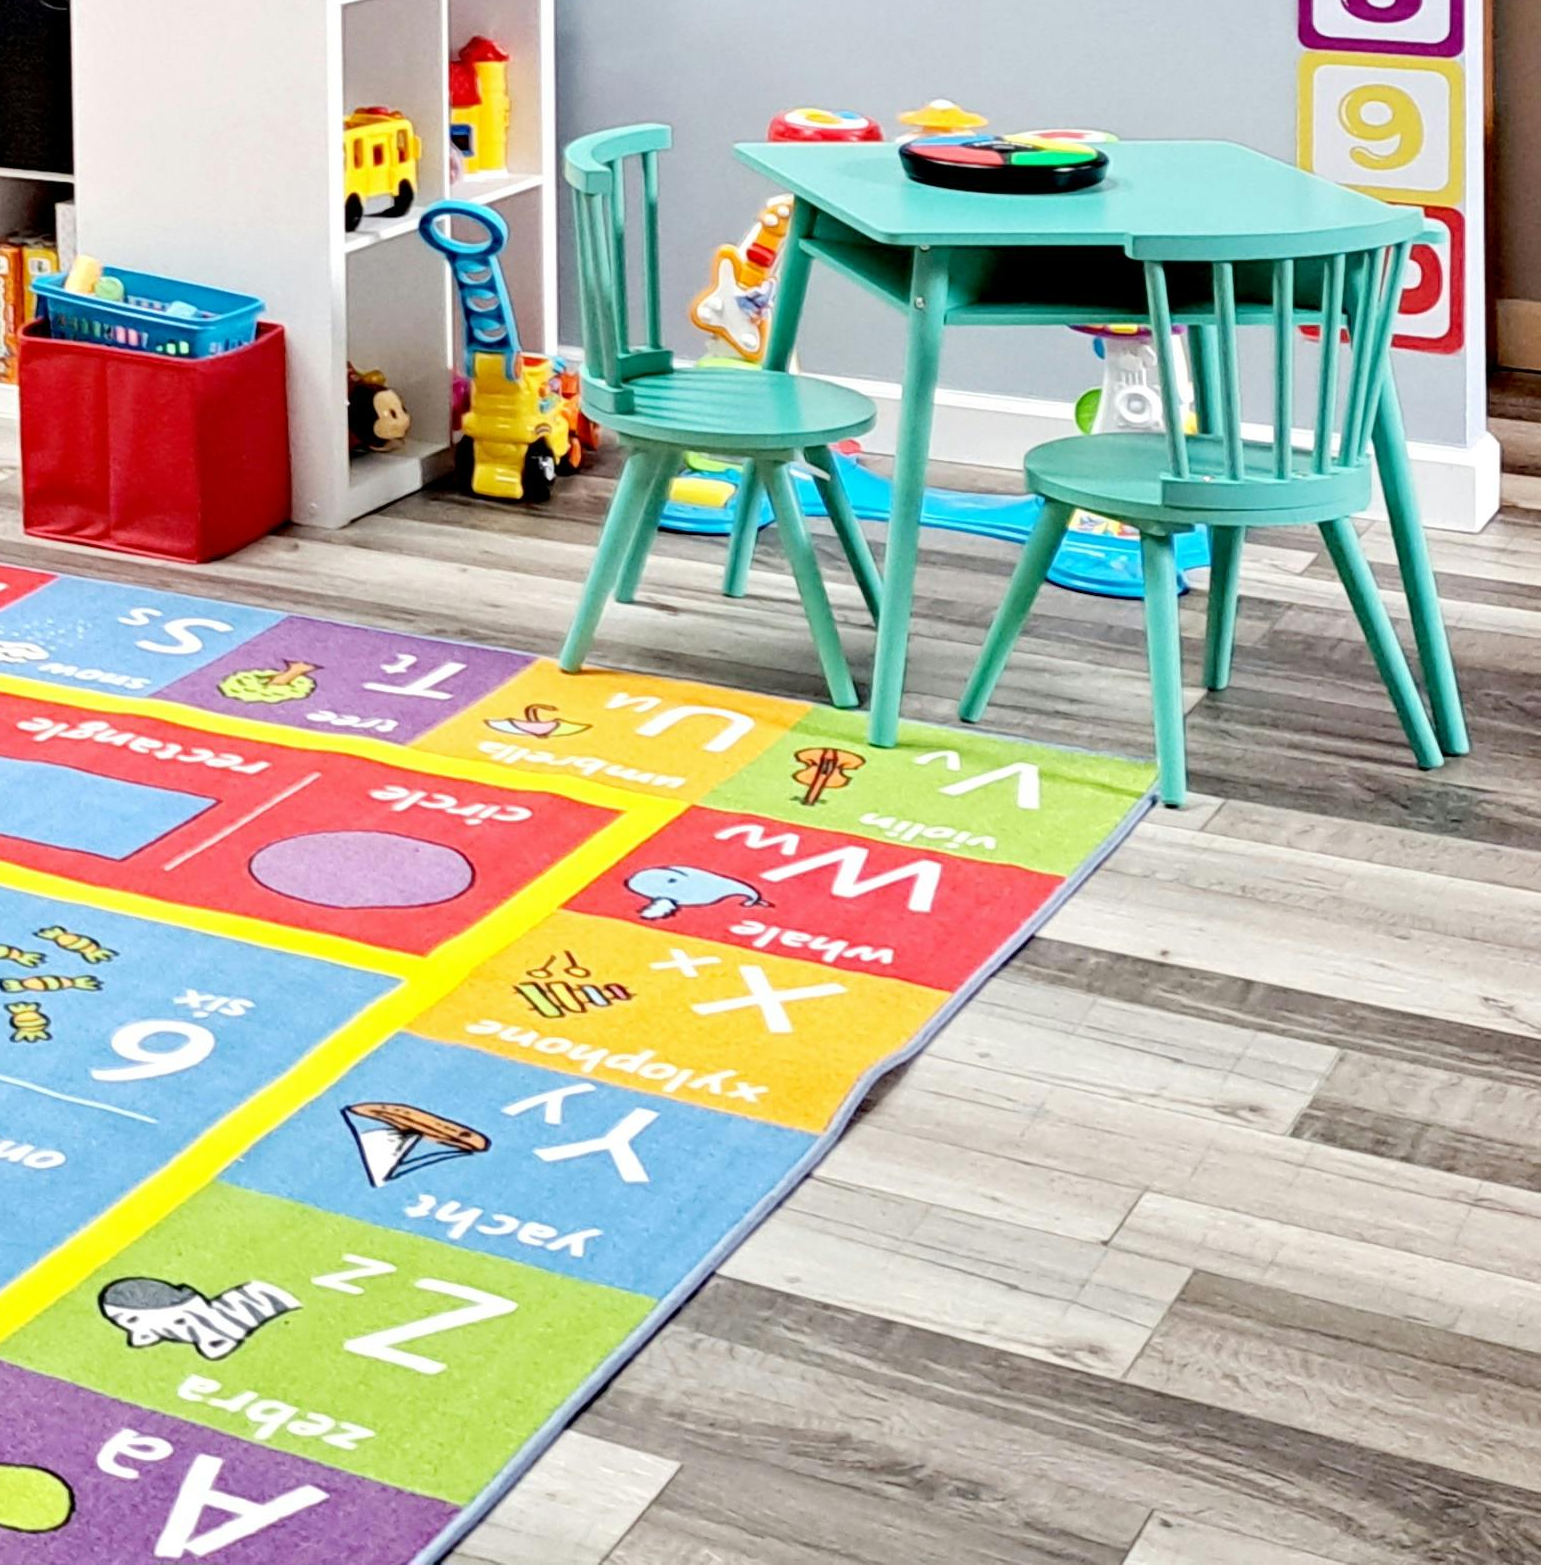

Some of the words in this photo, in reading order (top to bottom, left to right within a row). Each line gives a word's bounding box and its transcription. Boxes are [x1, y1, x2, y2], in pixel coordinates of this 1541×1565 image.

[1337, 83, 1424, 170] 9
[117, 607, 233, 655] Ss
[37, 662, 150, 690] snow
[363, 654, 466, 700] Tt
[18, 718, 270, 776] rectangle
[306, 710, 398, 733] tree
[607, 693, 754, 752] Uu
[479, 741, 684, 788] umbrella
[915, 751, 1040, 809] Vv
[371, 786, 531, 825] circle
[860, 813, 996, 849] violin
[715, 823, 943, 912] Ww
[730, 921, 893, 964] whale
[174, 989, 254, 1018] six
[650, 948, 847, 1033] Xx
[91, 1020, 215, 1082] 6
[468, 1021, 766, 1102] xylophone
[502, 1083, 659, 1182] Yy
[405, 1194, 601, 1257] yacht
[313, 1254, 518, 1374] Zz
[178, 1375, 374, 1450] zebra
[96, 1428, 329, 1558] Aa
